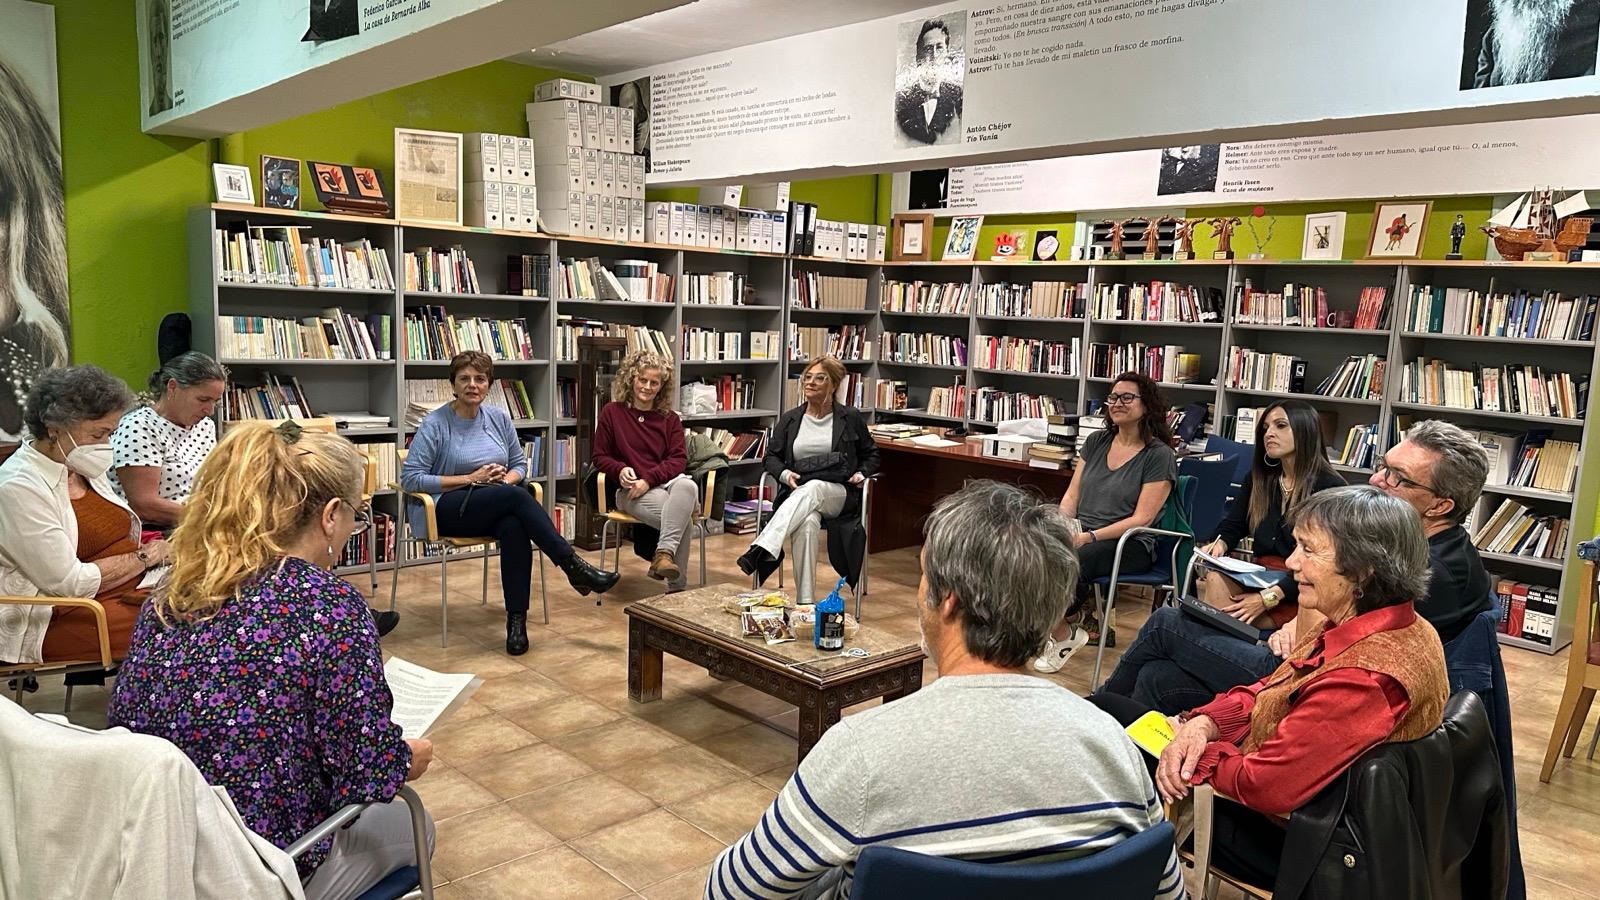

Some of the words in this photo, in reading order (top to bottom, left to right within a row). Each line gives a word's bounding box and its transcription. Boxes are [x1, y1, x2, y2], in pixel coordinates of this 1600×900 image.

[364, 4, 384, 18] Federico
[971, 9, 995, 18] Astrov:
[1056, 3, 1075, 12] años,
[364, 22, 370, 31] La
[371, 18, 383, 28] casa
[384, 14, 390, 24] de
[391, 5, 416, 21] Bernarda
[418, 0, 430, 12] Alba
[1020, 18, 1046, 27] nuestra
[1048, 13, 1071, 22] sangre
[974, 37, 991, 45] como
[1097, 15, 1112, 23] todo
[1114, 13, 1132, 21] esto,
[1162, 2, 1185, 12] hagas
[968, 66, 992, 74] Astrov:
[1026, 56, 1049, 65] llevado
[1114, 43, 1137, 52] frasco
[1151, 36, 1184, 47] morfina.
[969, 53, 1001, 64] Voinitski:
[1041, 42, 1063, 54] cogido
[988, 122, 1012, 131] Chéjov
